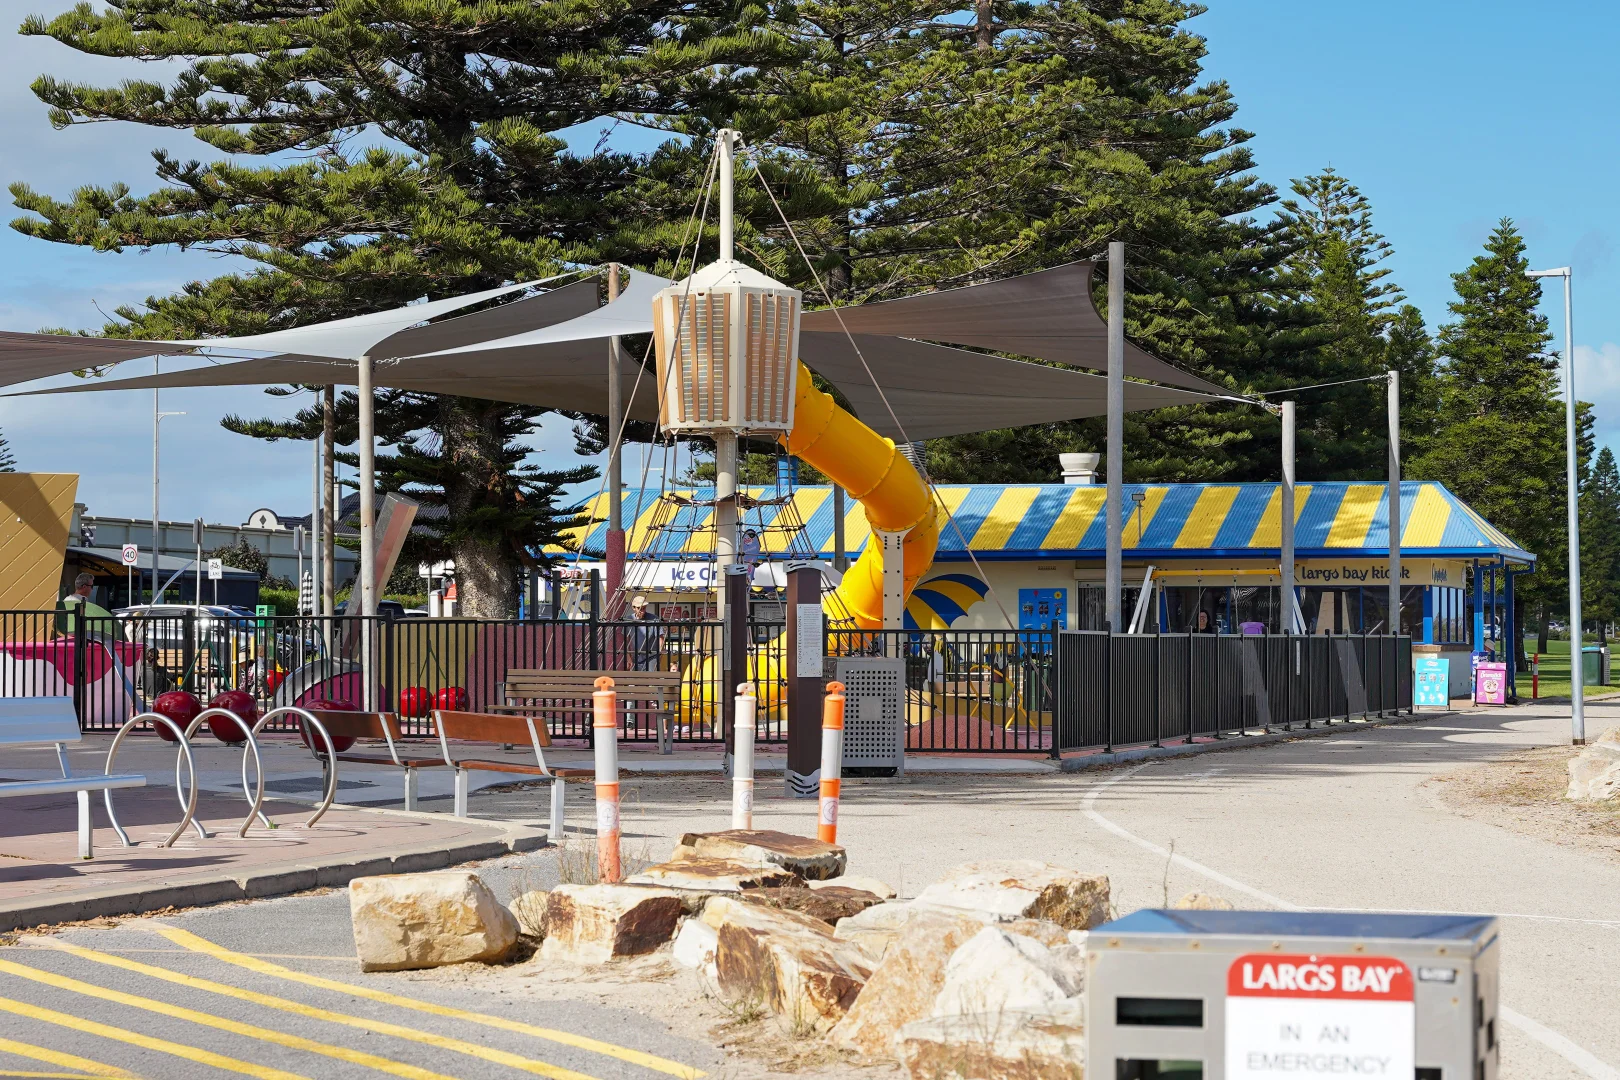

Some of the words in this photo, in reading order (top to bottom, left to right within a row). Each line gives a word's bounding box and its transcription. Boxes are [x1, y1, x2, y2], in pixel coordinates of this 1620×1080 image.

[125, 551, 134, 559] 40
[672, 567, 695, 581] Ice
[1302, 566, 1339, 582] largs
[1343, 566, 1368, 582] bay
[1243, 962, 1336, 991] LARGS
[1341, 965, 1394, 993] BAY
[1279, 1023, 1301, 1042] IN
[1318, 1025, 1349, 1043] AN
[1246, 1051, 1392, 1074] EMERGENCY
